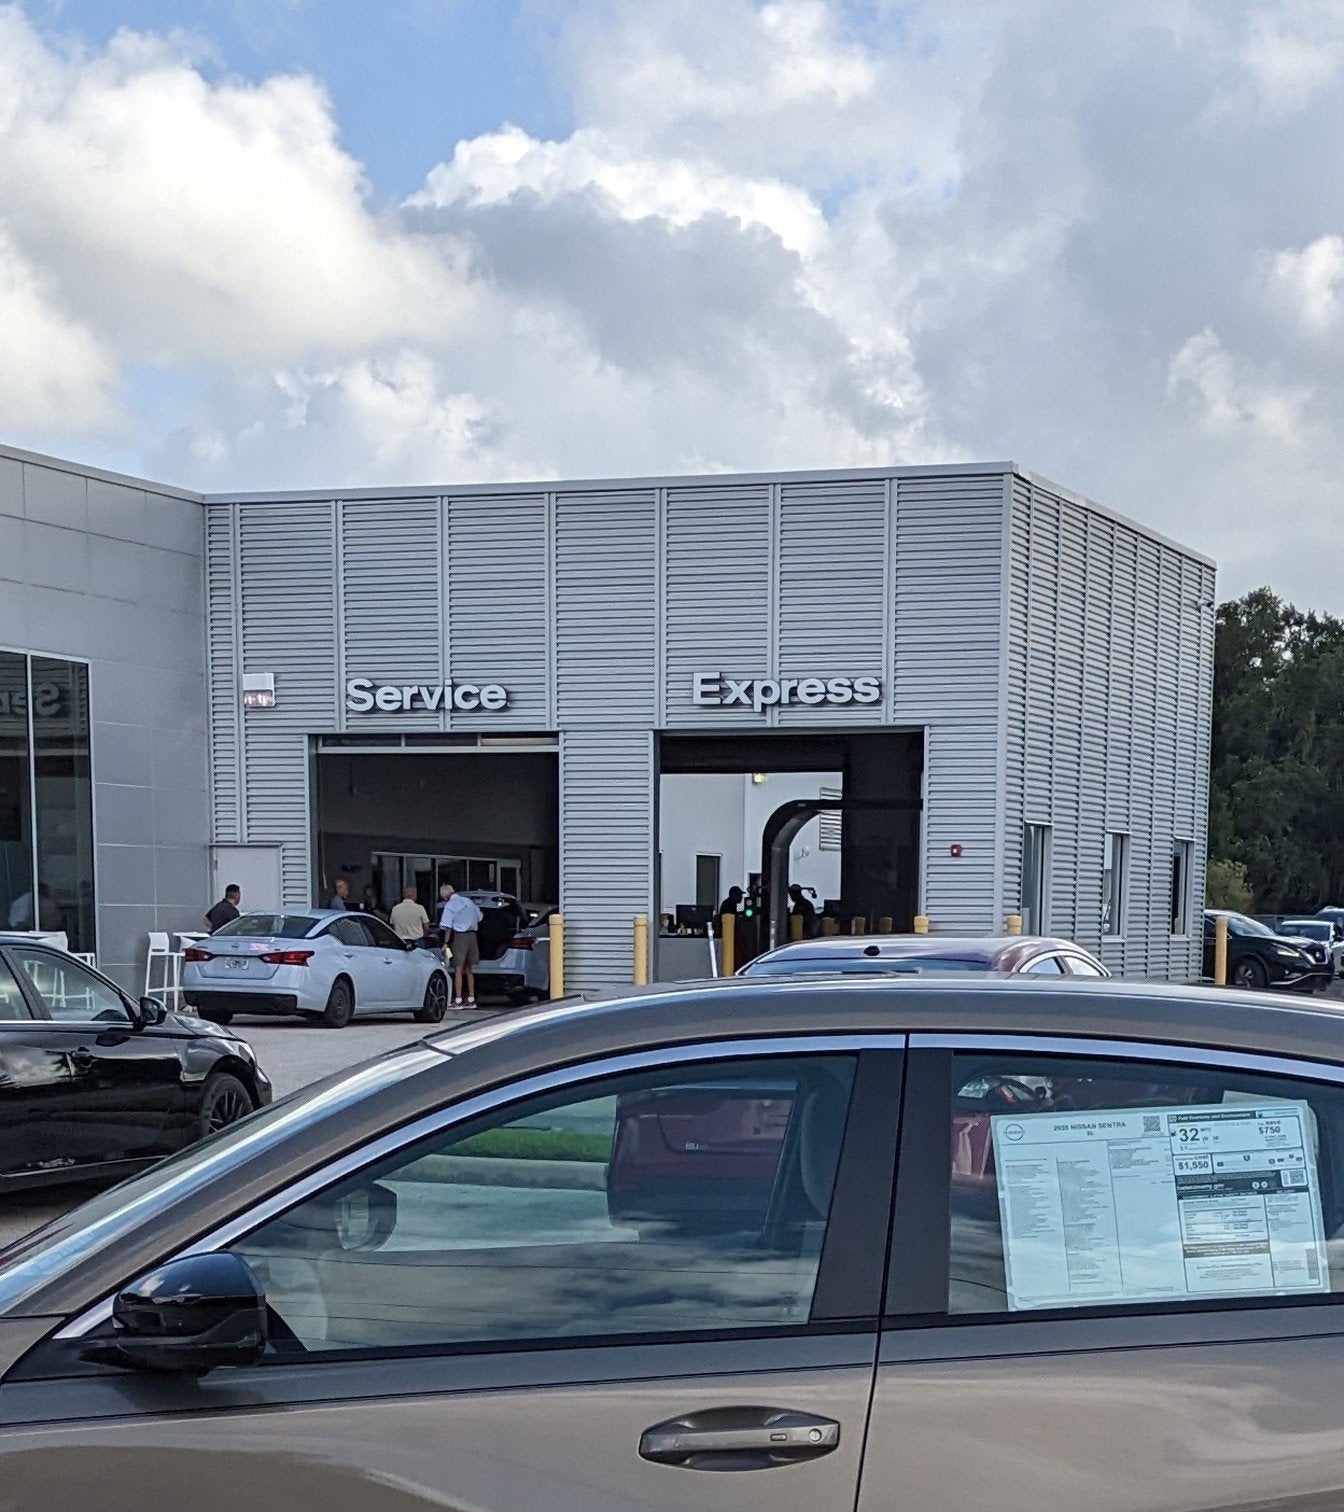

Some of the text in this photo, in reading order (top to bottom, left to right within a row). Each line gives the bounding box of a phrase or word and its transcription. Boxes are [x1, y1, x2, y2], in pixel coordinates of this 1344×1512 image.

[346, 672, 881, 712] Service Express
[1098, 1121, 1126, 1129] SENTRA
[1179, 1128, 1200, 1142] 32
